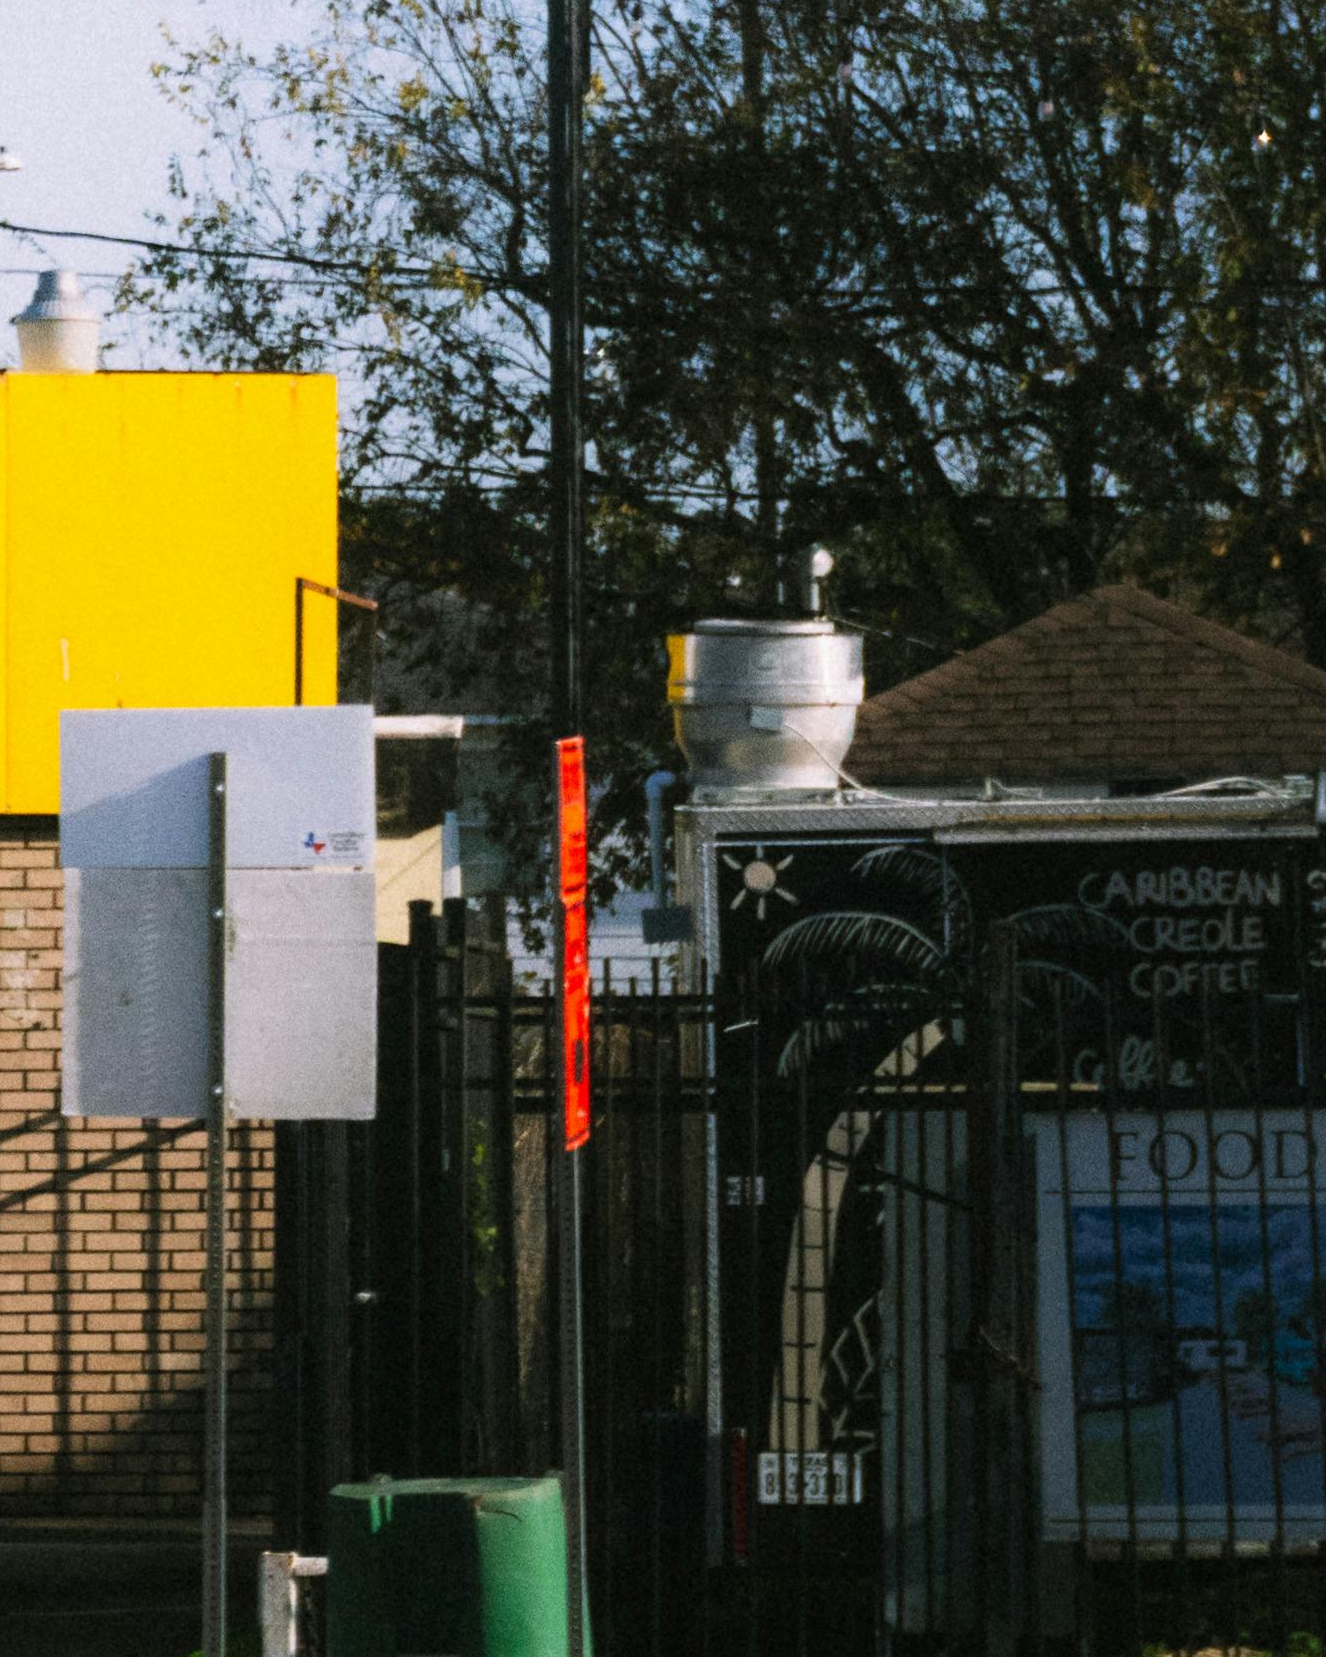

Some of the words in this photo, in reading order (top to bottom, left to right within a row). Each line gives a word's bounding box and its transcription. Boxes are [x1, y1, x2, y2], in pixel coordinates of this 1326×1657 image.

[1078, 866, 1281, 908] CARIBBEAN
[1129, 908, 1266, 953] CREOLE
[1112, 1130, 1315, 1181] FOOD
